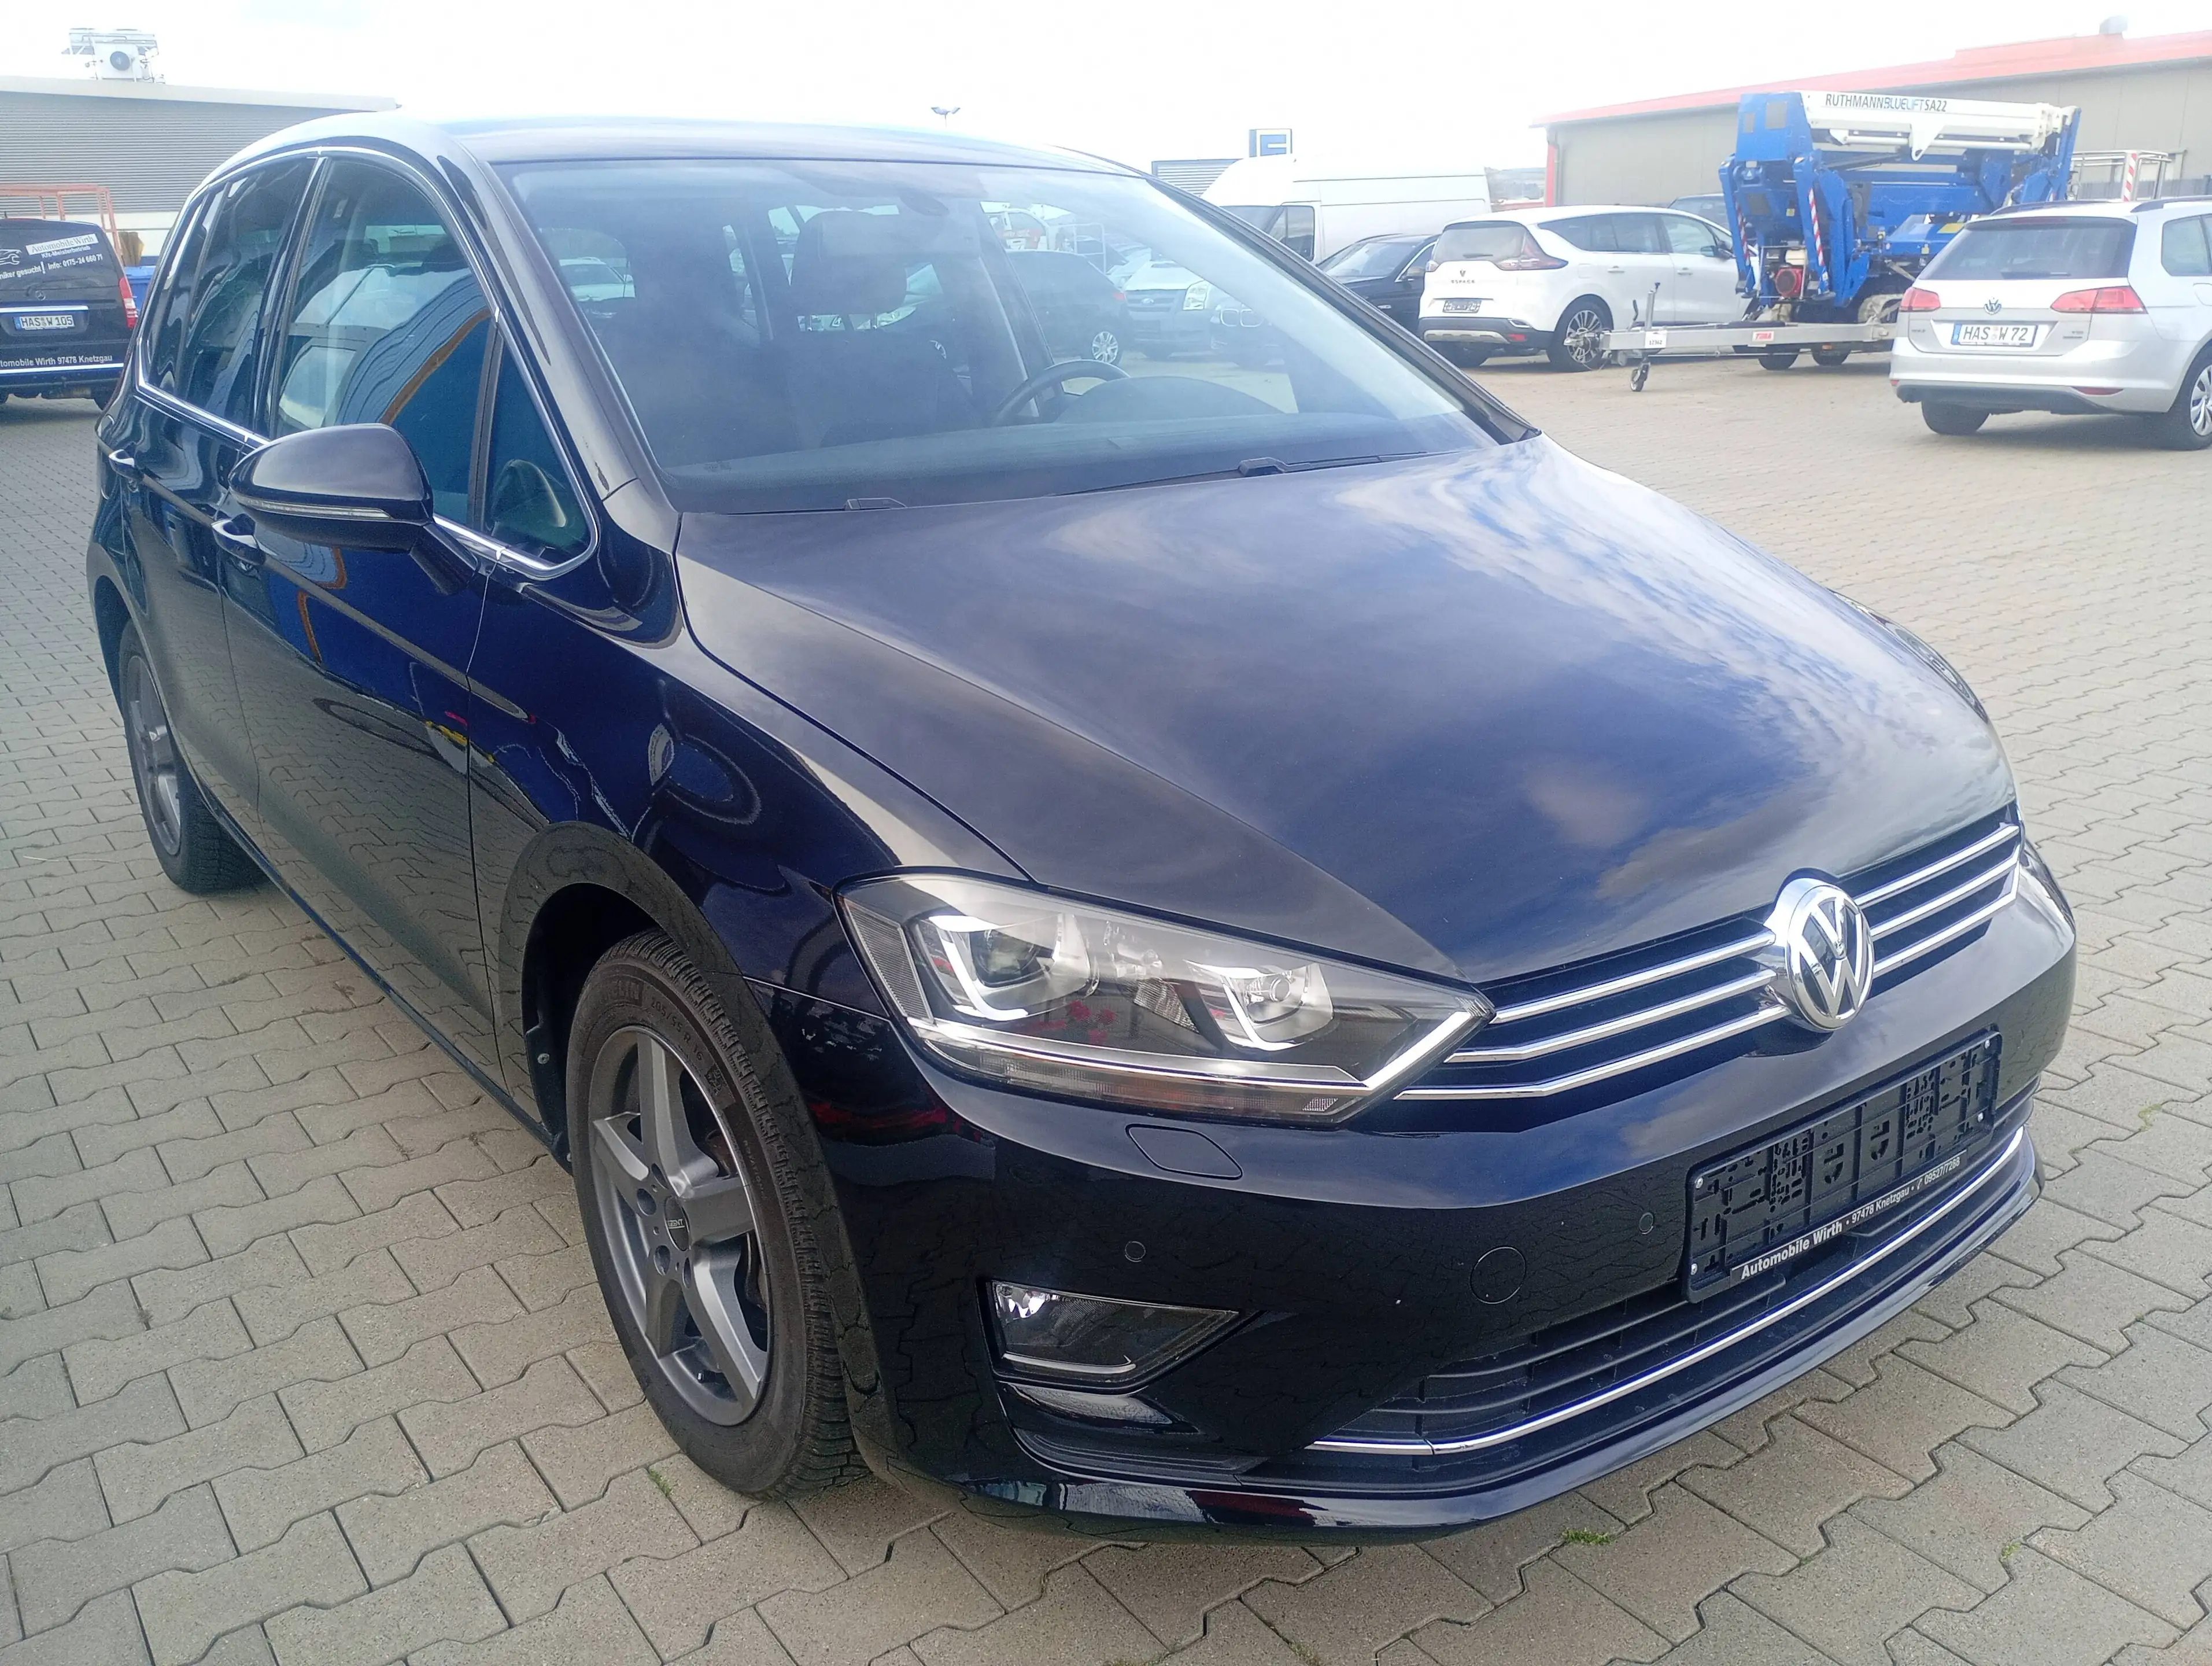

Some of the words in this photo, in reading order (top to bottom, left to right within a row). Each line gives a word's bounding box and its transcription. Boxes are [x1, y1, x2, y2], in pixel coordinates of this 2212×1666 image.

[1825, 93, 1884, 108] RUTHMANN
[1924, 99, 1948, 112] SA22
[31, 238, 74, 253] Automobile
[73, 234, 94, 245] Wirth
[48, 262, 62, 270] Info:
[20, 316, 41, 327] HAS
[47, 317, 53, 326] W
[56, 316, 73, 326] 105
[1962, 326, 1991, 340] HAS
[1998, 327, 2010, 340] W
[2010, 327, 2029, 341] 72
[35, 356, 56, 366] Wirth
[57, 356, 77, 365] 97478
[79, 355, 113, 364] Knetzgau
[1741, 1239, 1810, 1280] Automobile
[1812, 1221, 1843, 1245] Wirth
[1851, 1204, 1874, 1224] 97478
[1875, 1186, 1910, 1211] Knetzgau
